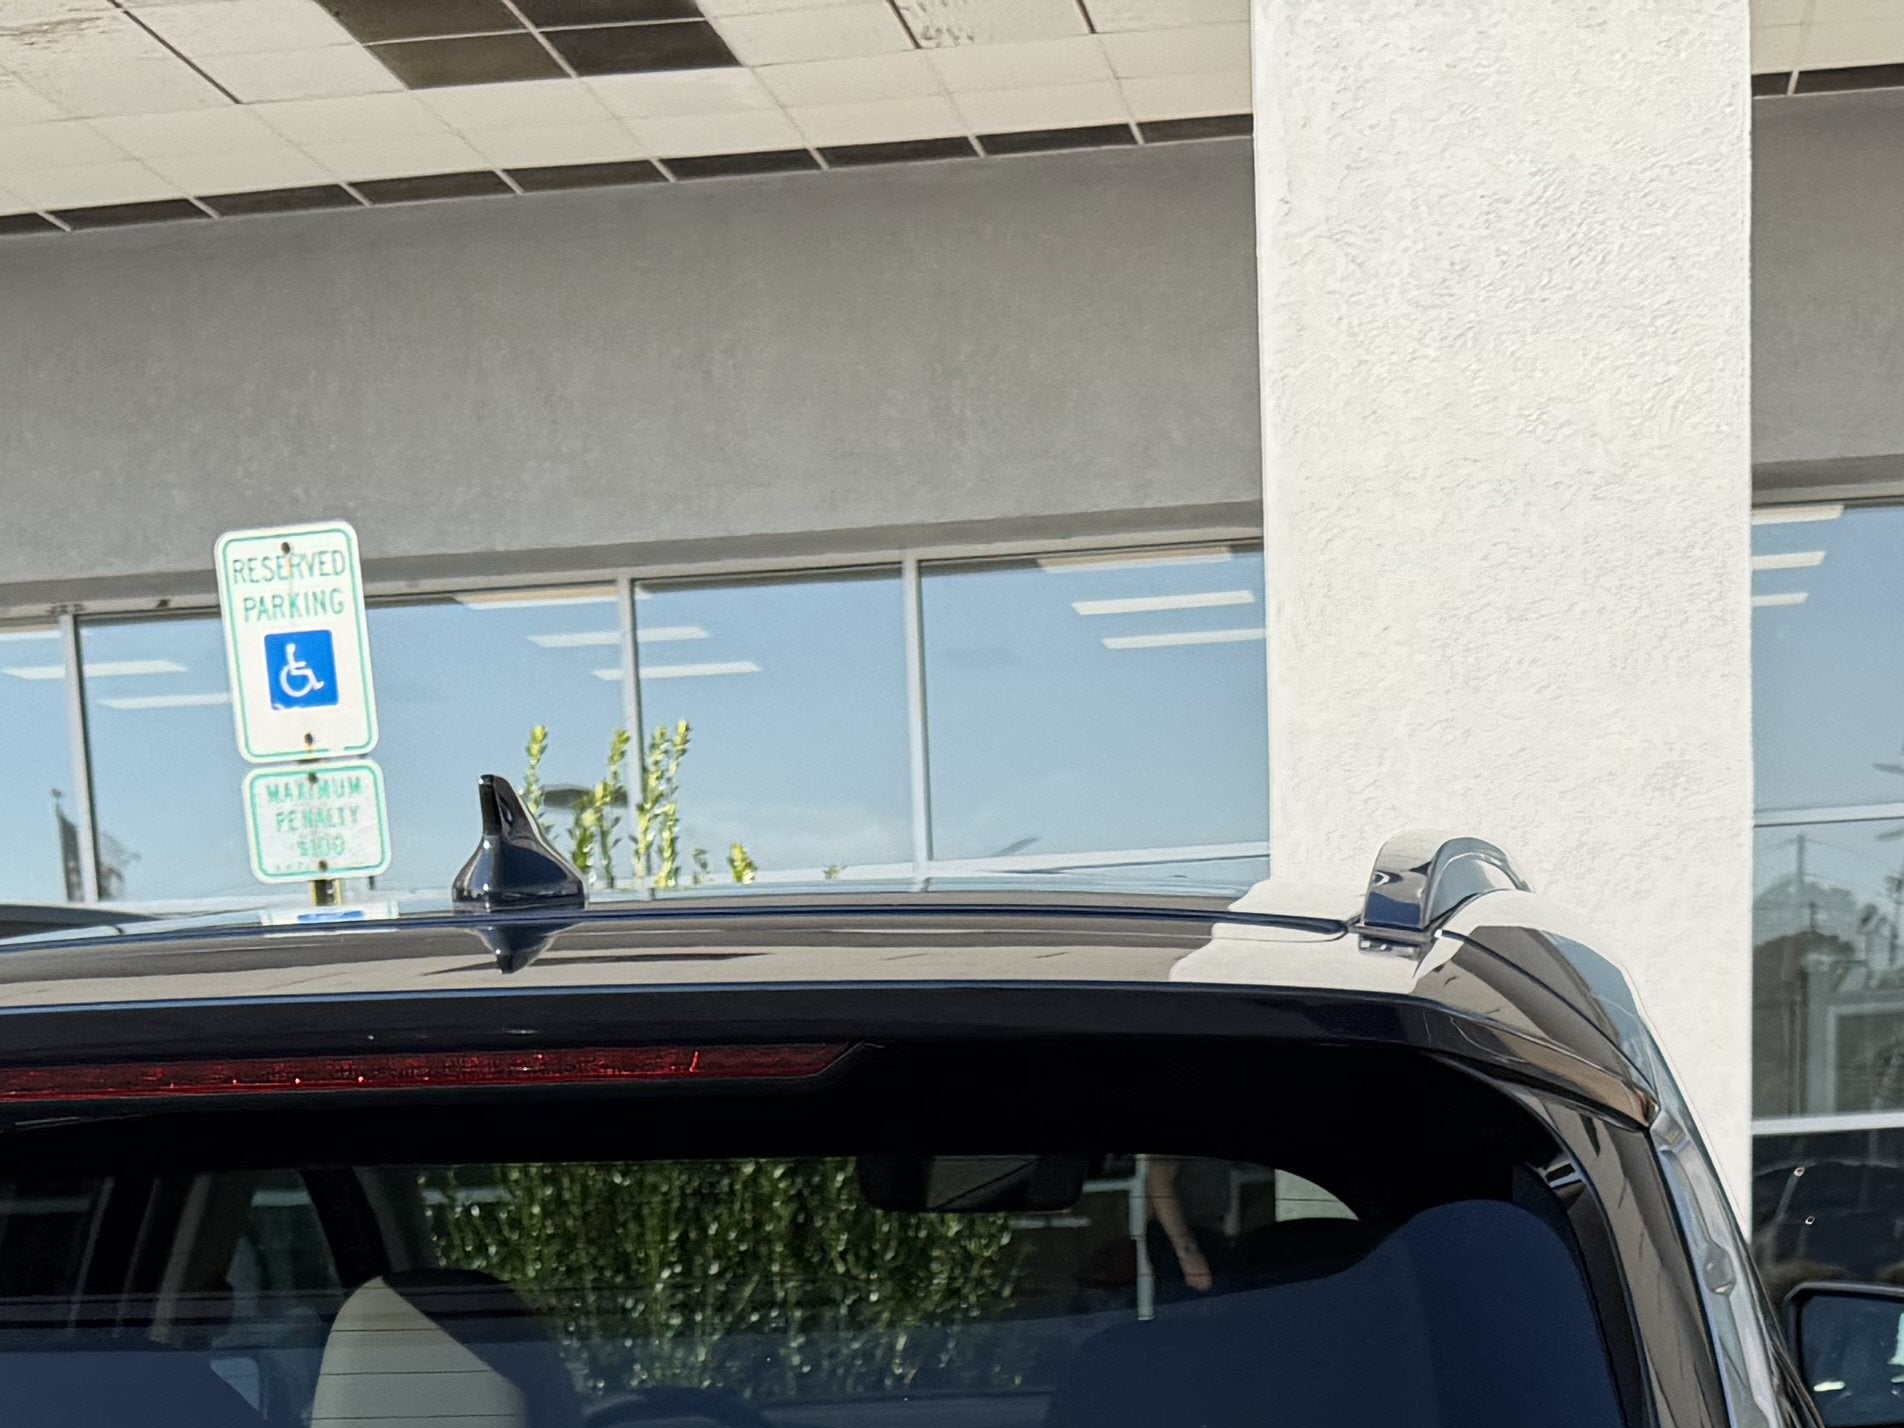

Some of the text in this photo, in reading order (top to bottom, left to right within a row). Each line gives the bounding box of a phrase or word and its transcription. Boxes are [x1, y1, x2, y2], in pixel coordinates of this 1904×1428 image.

[232, 549, 346, 585] RESERVED
[242, 587, 345, 623] PARKING
[265, 776, 363, 803] MAXIMUM
[275, 804, 361, 833] PENALTY
